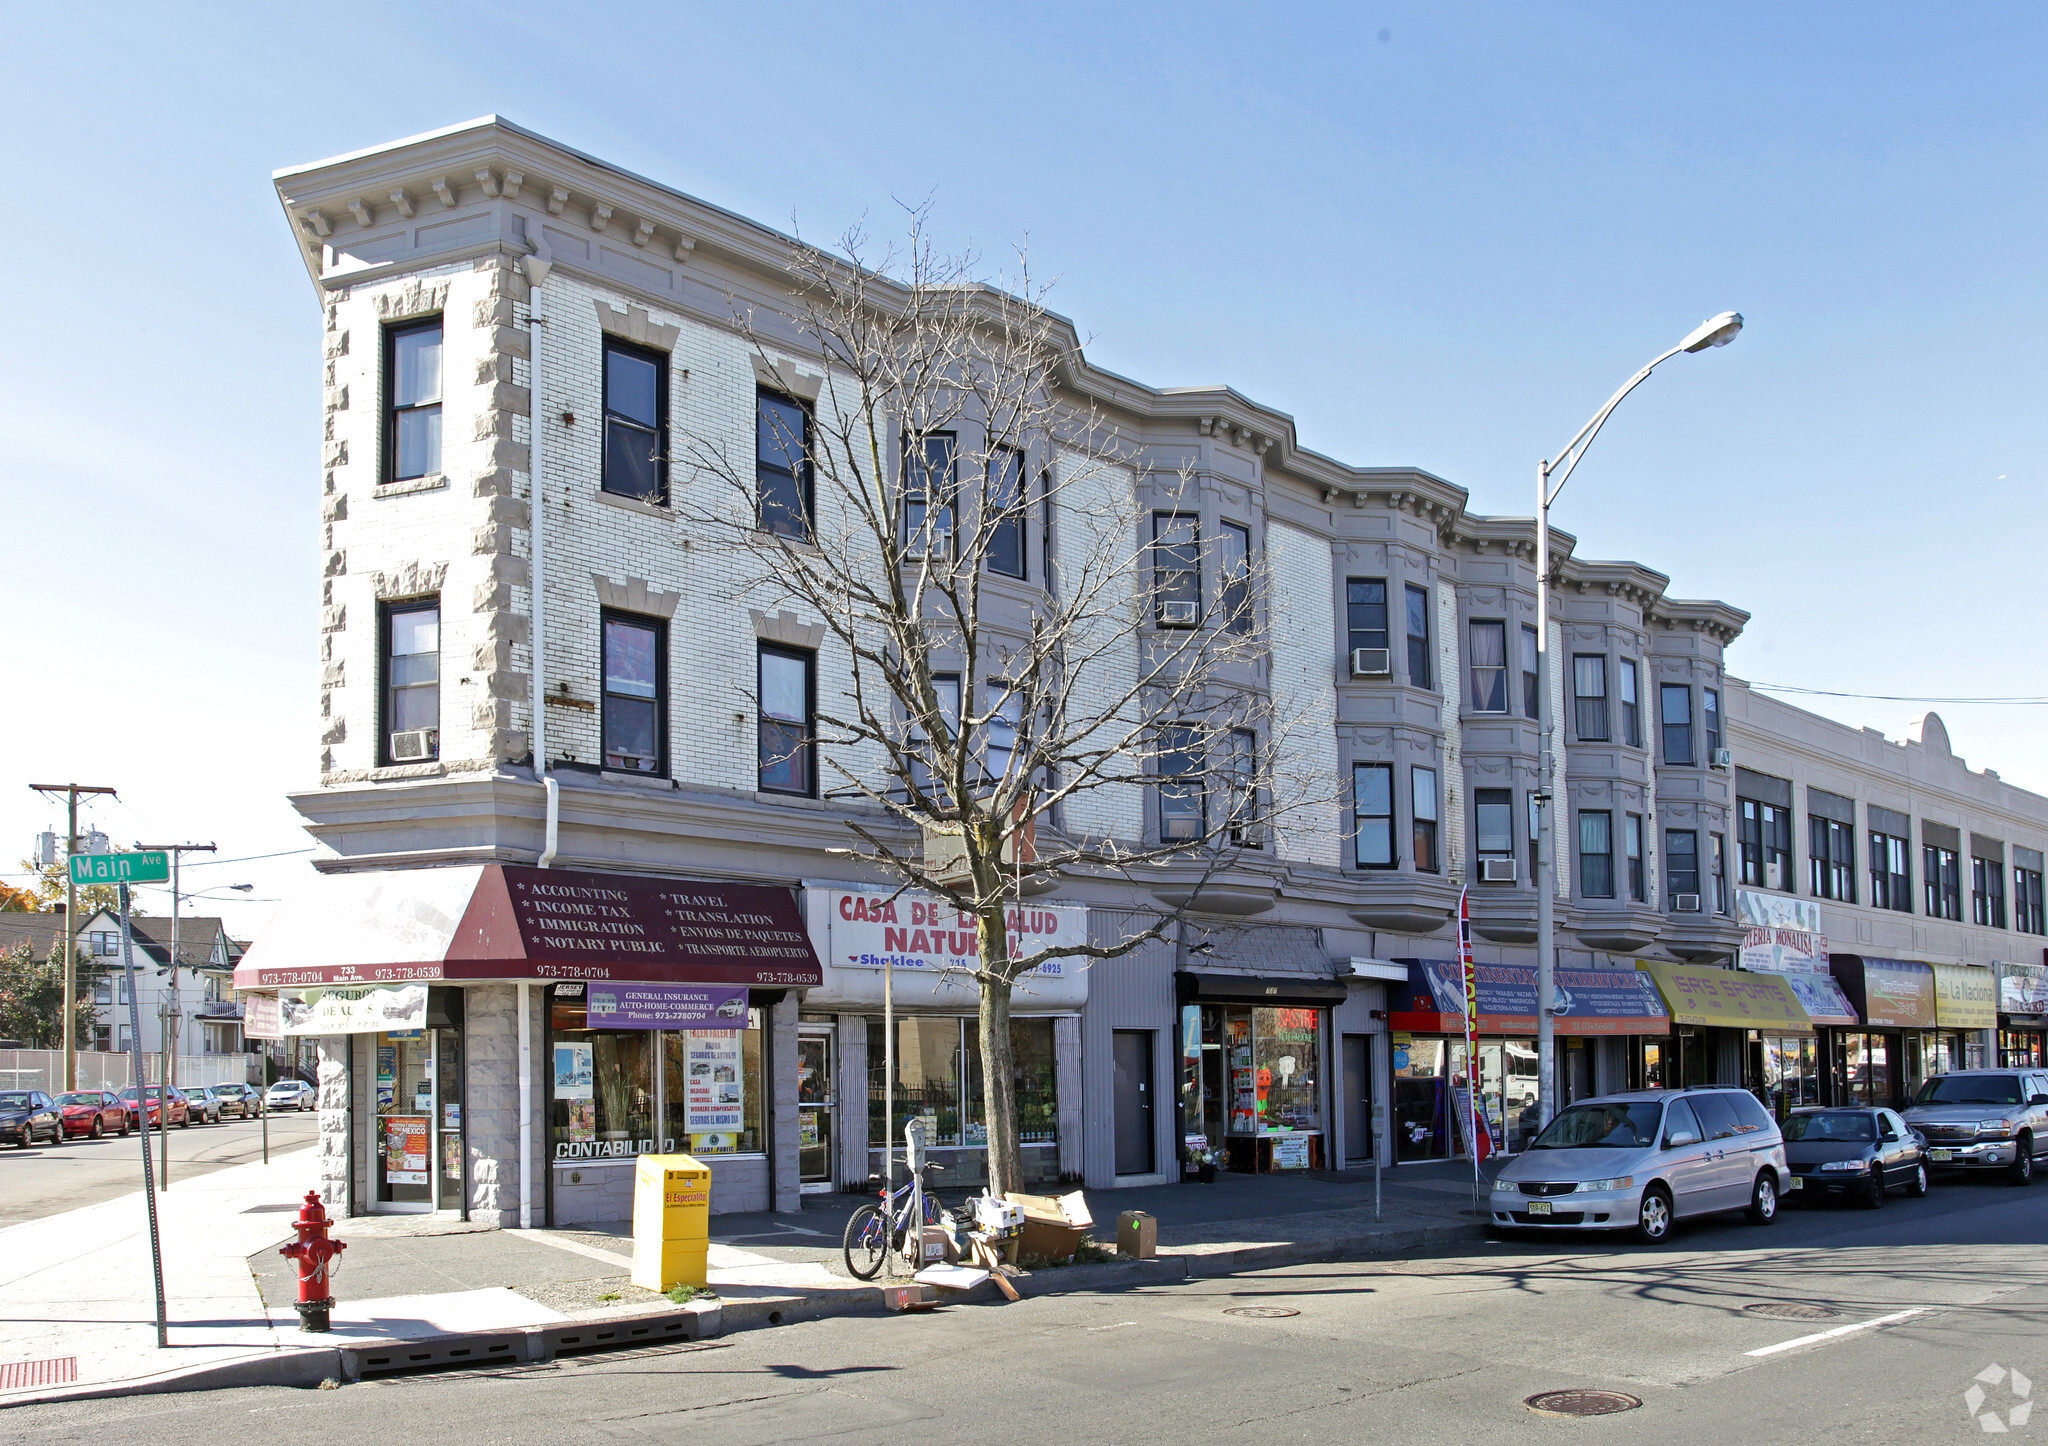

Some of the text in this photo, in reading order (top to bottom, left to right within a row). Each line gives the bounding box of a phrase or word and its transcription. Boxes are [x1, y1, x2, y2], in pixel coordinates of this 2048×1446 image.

[76, 855, 161, 878] Main Ave
[531, 883, 628, 901] ACCOUNTING
[670, 893, 728, 907] TRAVEL
[533, 901, 631, 918] INCOME TAX
[839, 896, 898, 924] CASA
[912, 902, 938, 927] DE
[1006, 911, 1058, 934] ALUD
[675, 910, 774, 926] TRANSLATION
[725, 929, 743, 939] DE
[746, 931, 802, 944] PAQUETES
[885, 927, 1023, 959] NATURL
[544, 936, 665, 953] NOTARY PUBLIC
[685, 943, 809, 958] TRANSPORTE AEROPUERTO
[1776, 930, 1813, 959] MONALISA
[860, 954, 924, 967] Shaklee
[262, 971, 323, 984] 973-778-0704
[375, 967, 441, 979] 973-778-0539
[537, 965, 610, 979] 973-778-0704
[757, 972, 818, 984] 973-778-0539
[625, 992, 709, 1002] GENERAL INSURANCE
[1720, 980, 1786, 1001] SPORTS
[1950, 980, 1995, 1002] La Nacional
[619, 1001, 714, 1011] AUTO-HOME-COMMERCE
[628, 1011, 706, 1020] Phone: 973-7780704
[1277, 1008, 1318, 1029] SASTRE
[691, 1051, 710, 1059] SEGUROS
[690, 1115, 710, 1124] SEGUROS
[710, 1115, 715, 1124] EL
[715, 1115, 730, 1124] MISMO
[666, 1192, 707, 1203] El Especialito
